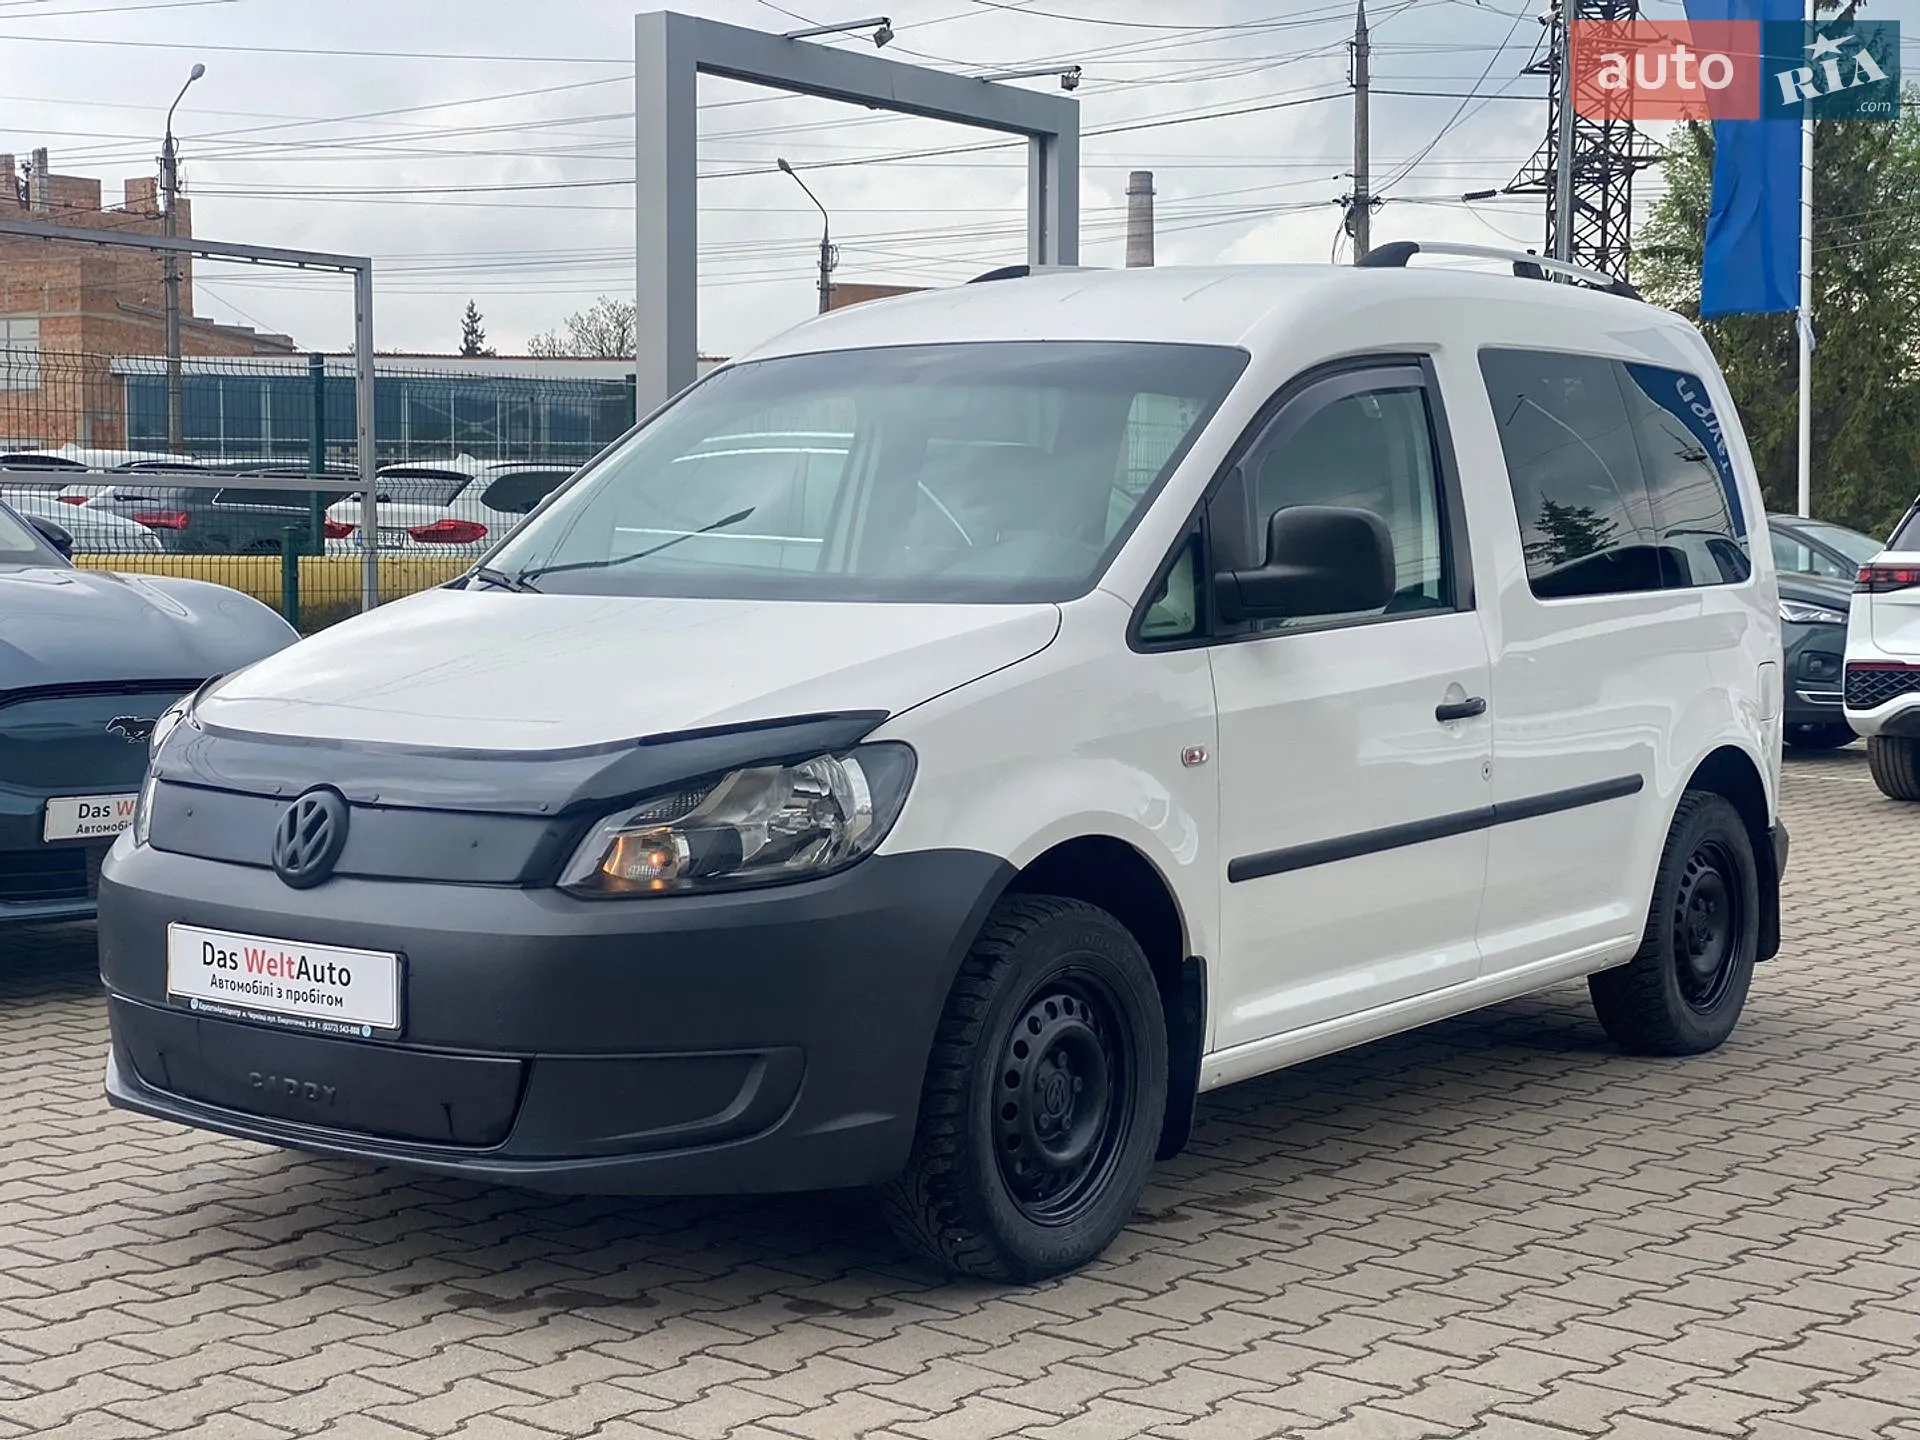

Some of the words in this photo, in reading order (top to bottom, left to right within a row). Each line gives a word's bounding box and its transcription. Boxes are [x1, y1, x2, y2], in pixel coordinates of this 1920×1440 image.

[78, 803, 111, 819] Das
[76, 821, 132, 835] Автомобі
[202, 941, 238, 971] Das
[244, 947, 351, 987] WeltAuto
[210, 973, 273, 997] Автомобілі
[286, 988, 343, 1007] пробігом
